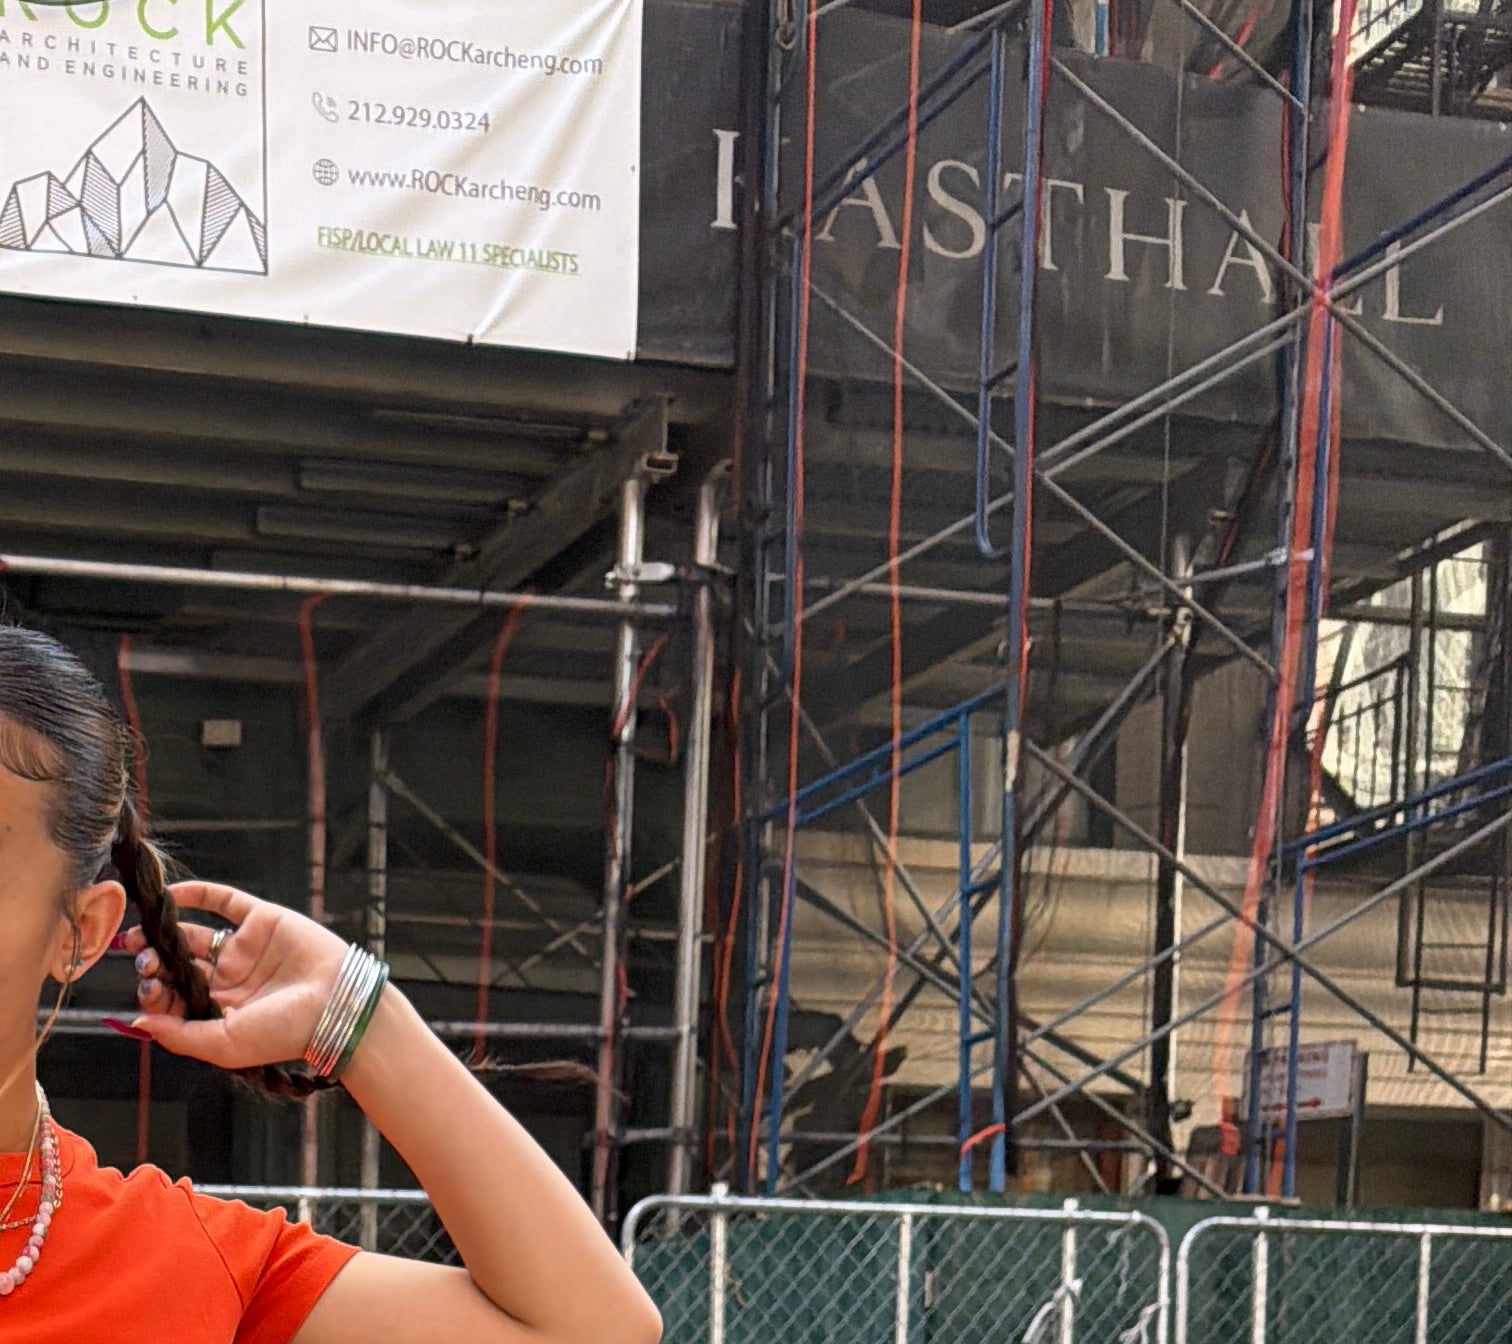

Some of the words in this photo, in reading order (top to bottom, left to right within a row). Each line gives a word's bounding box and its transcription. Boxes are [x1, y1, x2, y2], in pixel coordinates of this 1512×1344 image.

[346, 29, 604, 76] INFO@ROCKarcheng.com
[64, 59, 248, 98] ENGINEERING
[348, 100, 490, 133] 212.929.0324
[348, 169, 602, 211] www.ROCKarcheng.com
[317, 226, 411, 256] FISP/LOCAL
[416, 238, 456, 260] LAW
[460, 242, 479, 262] 11
[483, 243, 580, 274] SPECIALISTS
